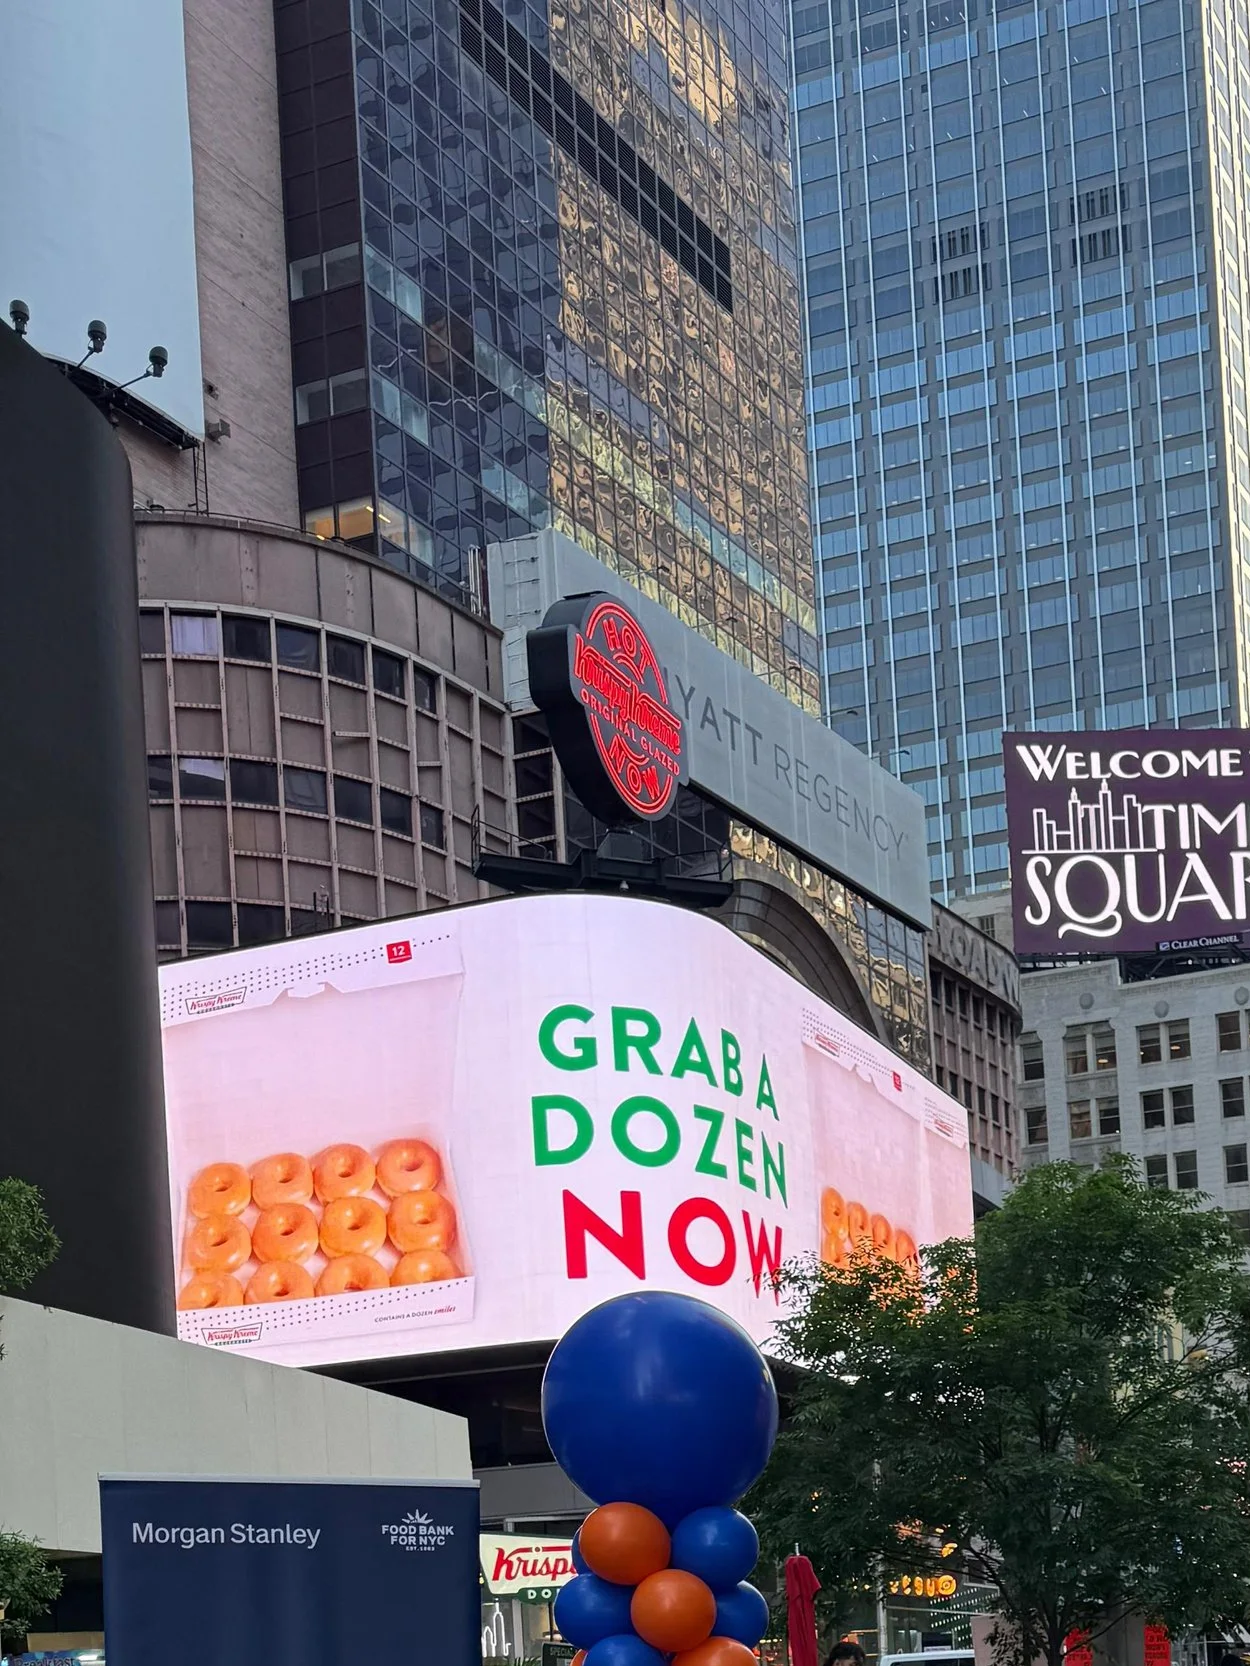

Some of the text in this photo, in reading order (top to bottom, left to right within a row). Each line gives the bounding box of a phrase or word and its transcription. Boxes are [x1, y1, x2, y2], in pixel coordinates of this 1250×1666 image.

[603, 617, 650, 675] HOT
[580, 689, 680, 777] ORIGINAL GLAZED
[609, 733, 660, 800] NOW
[1016, 744, 1243, 781] WELCOME
[774, 744, 905, 861] REGENCY
[392, 945, 406, 957] 12
[1171, 935, 1239, 950] CLEAR CHANNEL
[538, 1004, 779, 1121] GRAB A
[531, 1095, 788, 1209] DOZEN
[562, 1189, 783, 1306] NOW
[132, 1523, 321, 1549] Morgan Stanley
[381, 1525, 454, 1536] FOOD BANK
[390, 1535, 446, 1546] FOR NYC
